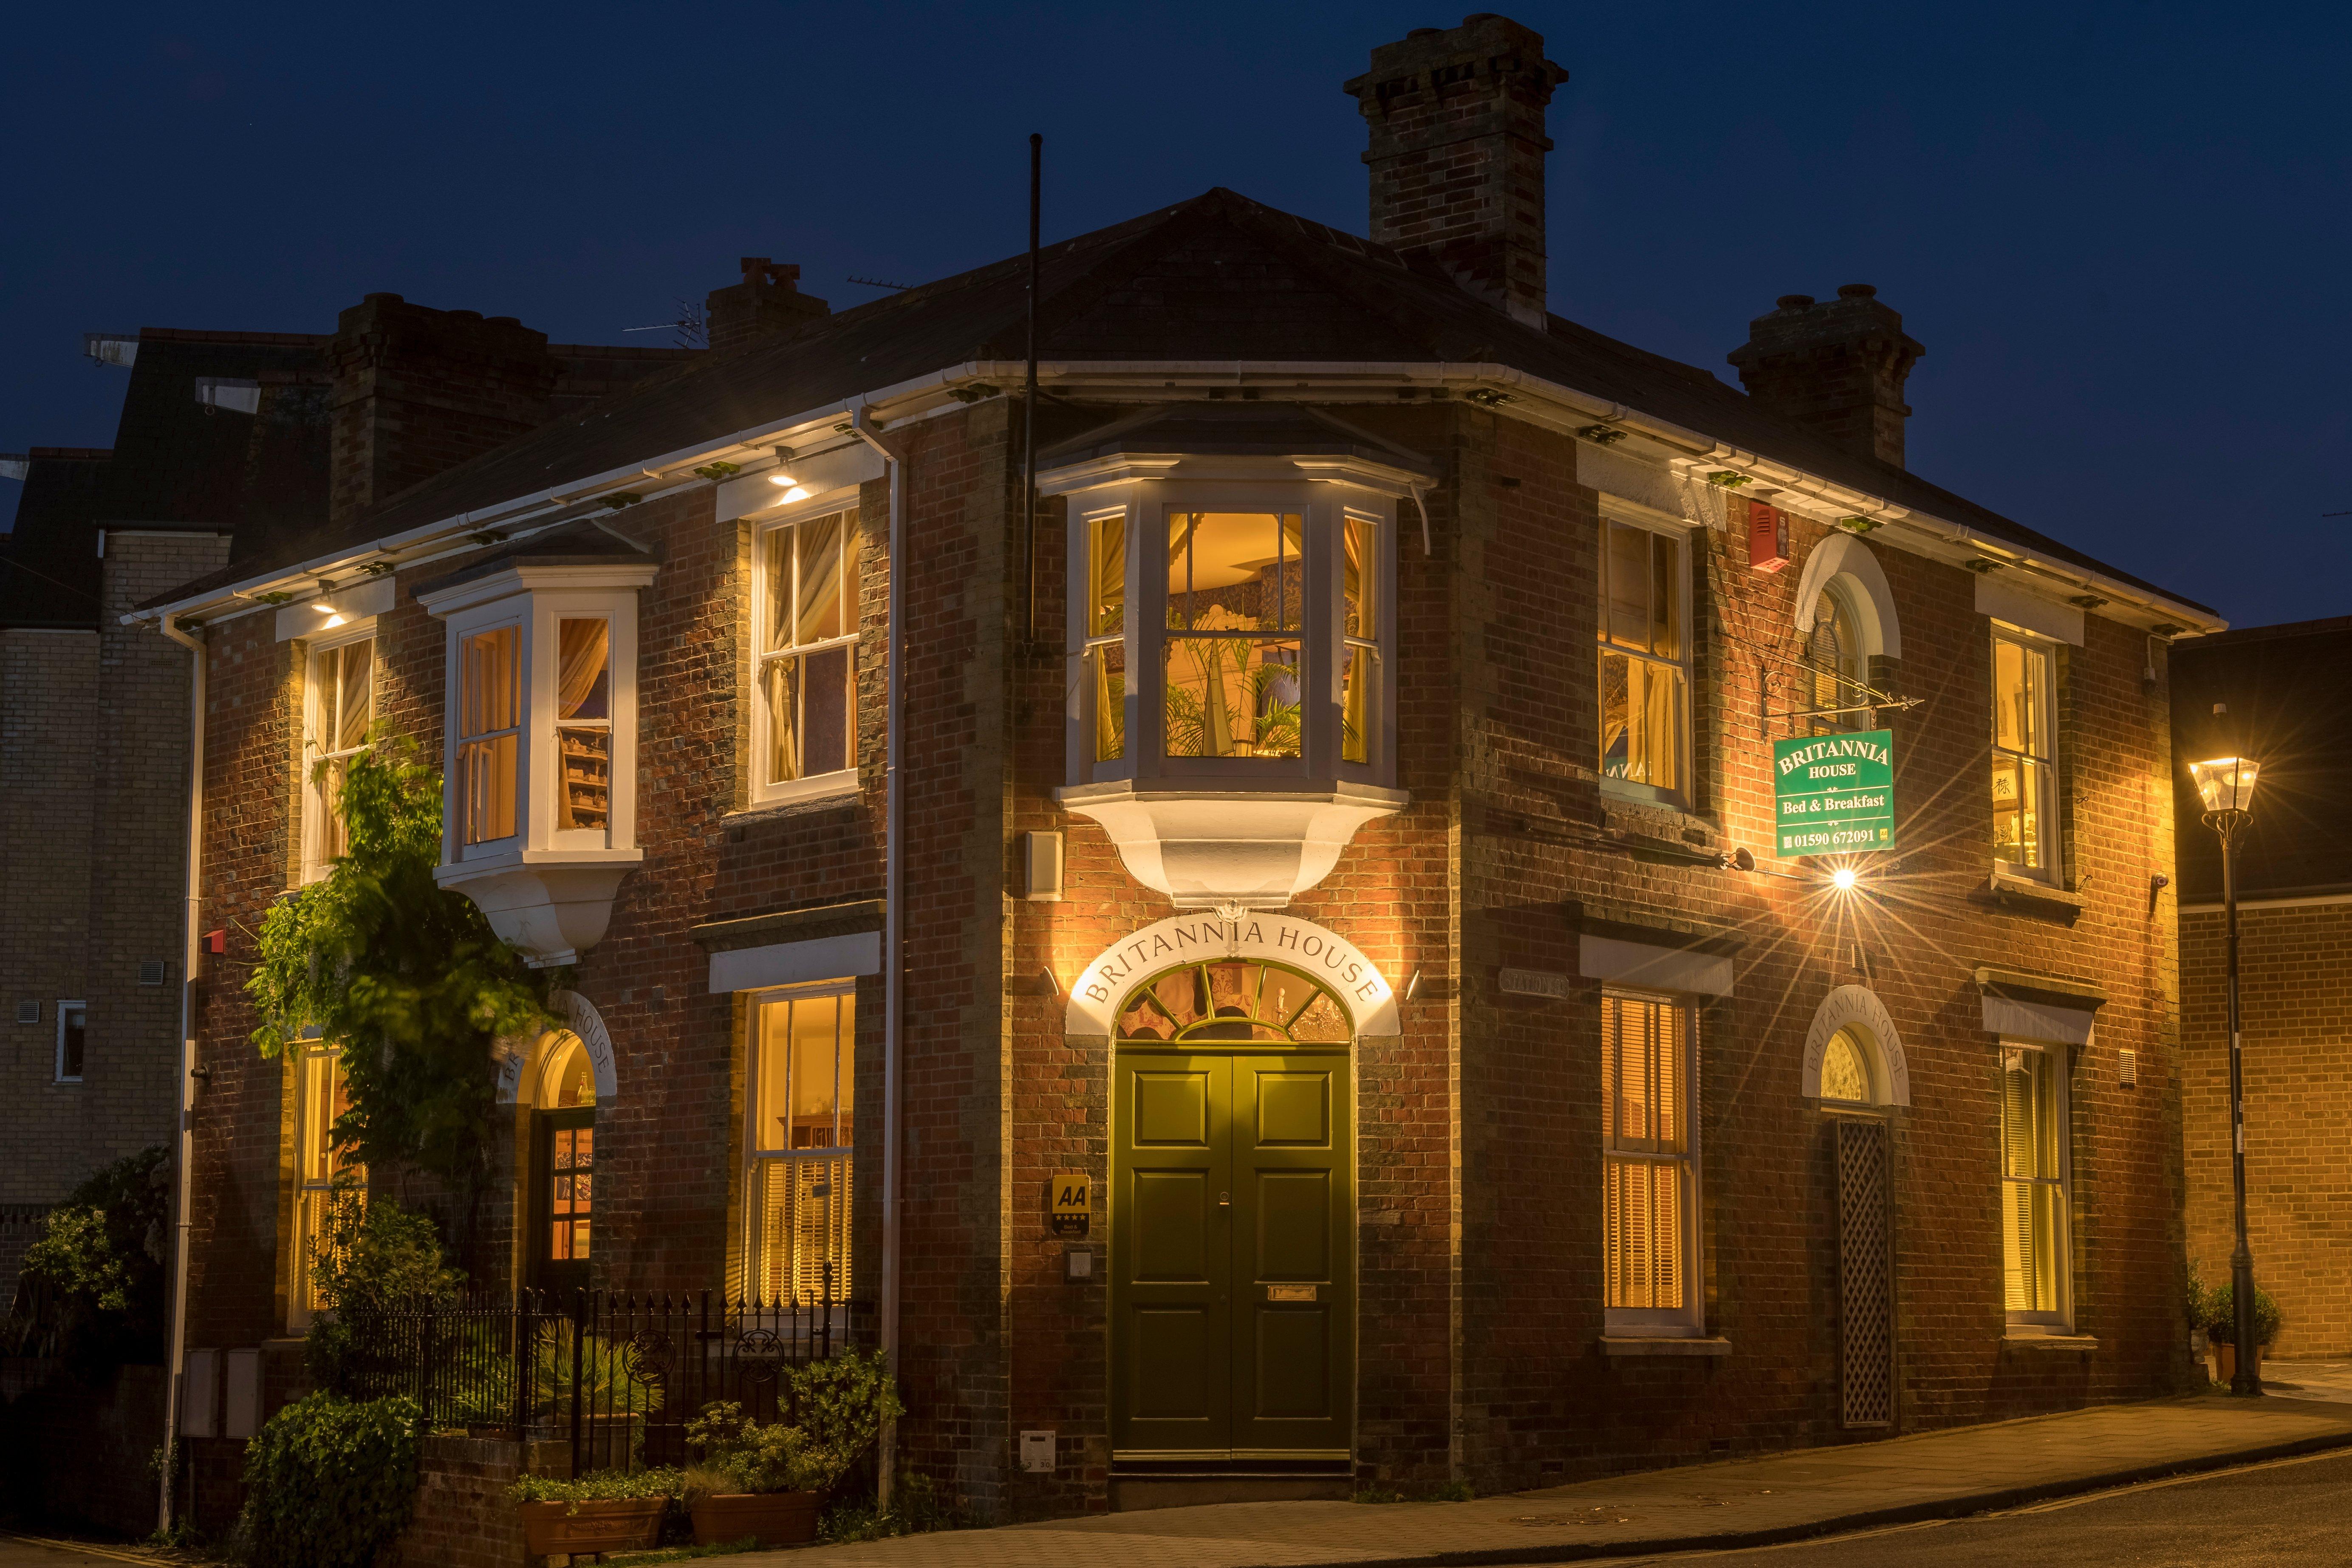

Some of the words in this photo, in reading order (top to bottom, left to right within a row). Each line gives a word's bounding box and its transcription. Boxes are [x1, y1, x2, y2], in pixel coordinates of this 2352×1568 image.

[1778, 740, 1888, 776] BRITANNIA
[1809, 763, 1856, 779] HOUSE
[1783, 801, 1806, 814] Bed
[1809, 799, 1821, 812] &
[1824, 794, 1885, 811] Breakfast
[1794, 833, 1829, 848] 01590
[1832, 829, 1874, 844] 672091
[1085, 921, 1264, 1004] BRITANNIA
[1277, 927, 1379, 1002] HOUSE
[1501, 972, 1549, 994] STATION
[574, 1005, 609, 1074] HOUSE
[1808, 993, 1867, 1072] BRITANNIA
[1872, 1005, 1904, 1082] HOUSE
[1057, 1186, 1086, 1206] AA
